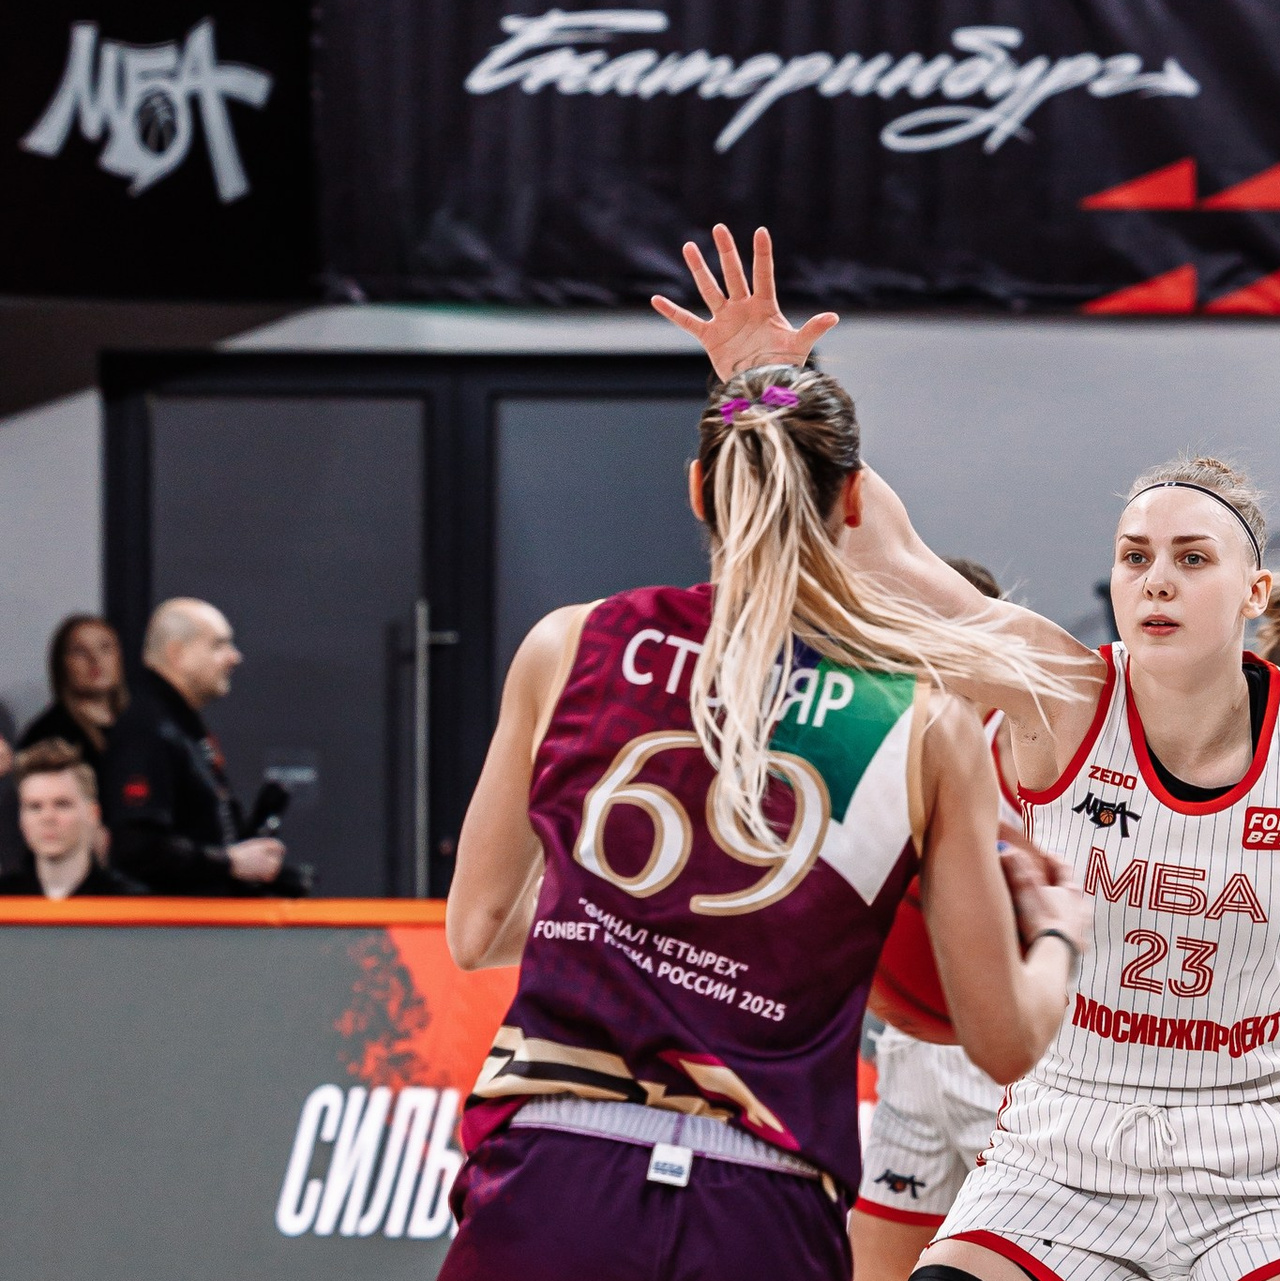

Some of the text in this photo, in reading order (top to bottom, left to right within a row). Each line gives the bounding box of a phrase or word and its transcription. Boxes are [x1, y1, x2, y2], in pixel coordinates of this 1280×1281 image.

[465, 8, 1200, 152] Екатеринбург
[620, 628, 857, 728] СТЯР
[574, 729, 832, 915] 69
[1088, 765, 1138, 791] ZEDO
[1084, 847, 1268, 924] МБА
[533, 920, 600, 942] FONBET
[657, 961, 737, 1004] РОССИИ
[738, 991, 787, 1022] 2025
[653, 933, 749, 979] ЧЕТЫРЕХ"
[1120, 928, 1218, 998] 23
[275, 1083, 461, 1240] СИЛЬ
